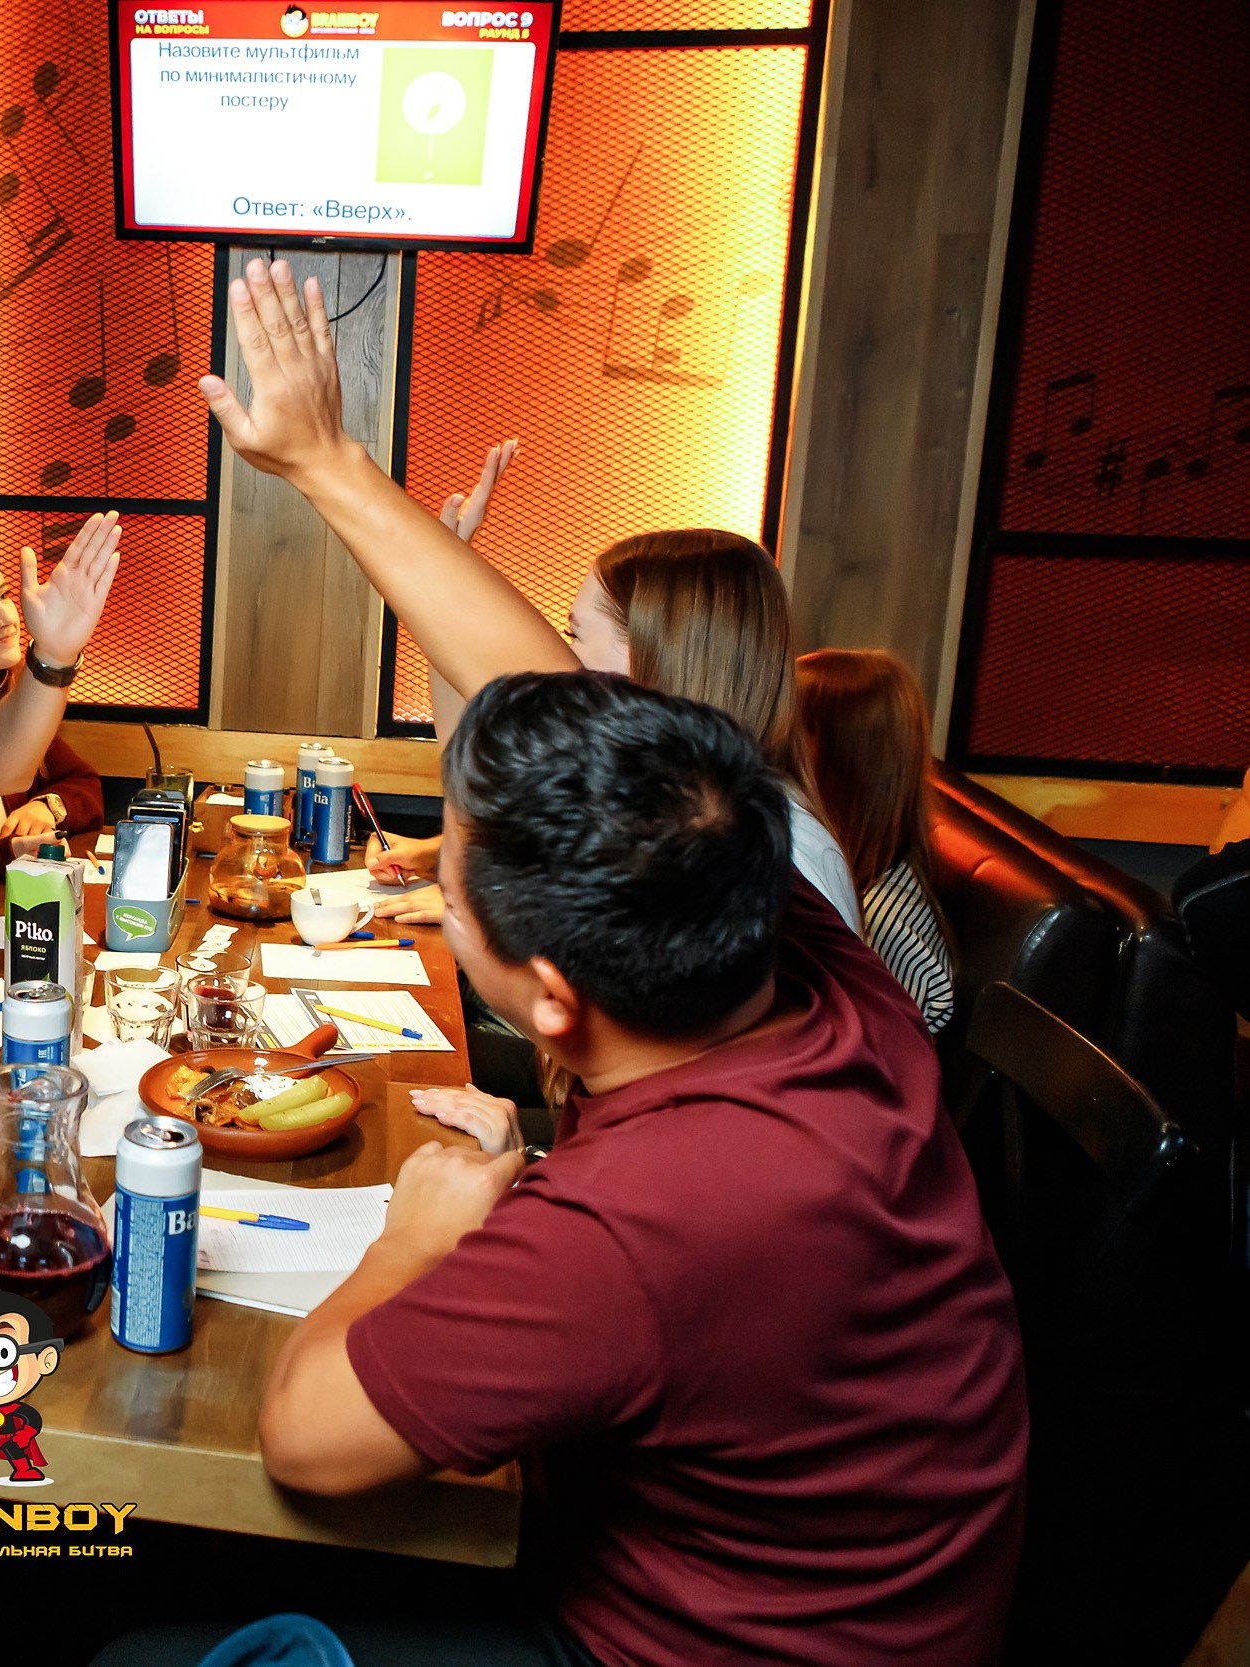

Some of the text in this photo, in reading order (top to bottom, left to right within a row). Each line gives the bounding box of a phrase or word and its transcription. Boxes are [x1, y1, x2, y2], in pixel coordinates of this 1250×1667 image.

[134, 9, 204, 25] ОТВЕТЫ
[441, 11, 533, 27] ВОПРОС 9
[135, 25, 210, 35] НА ВОПРОСЫ
[158, 42, 360, 62] Назовите мультфильм
[160, 70, 357, 87] по минималистичному
[232, 196, 412, 223] Ответ: «Вверх».
[21, 945, 46, 953] ЯБЛОКО
